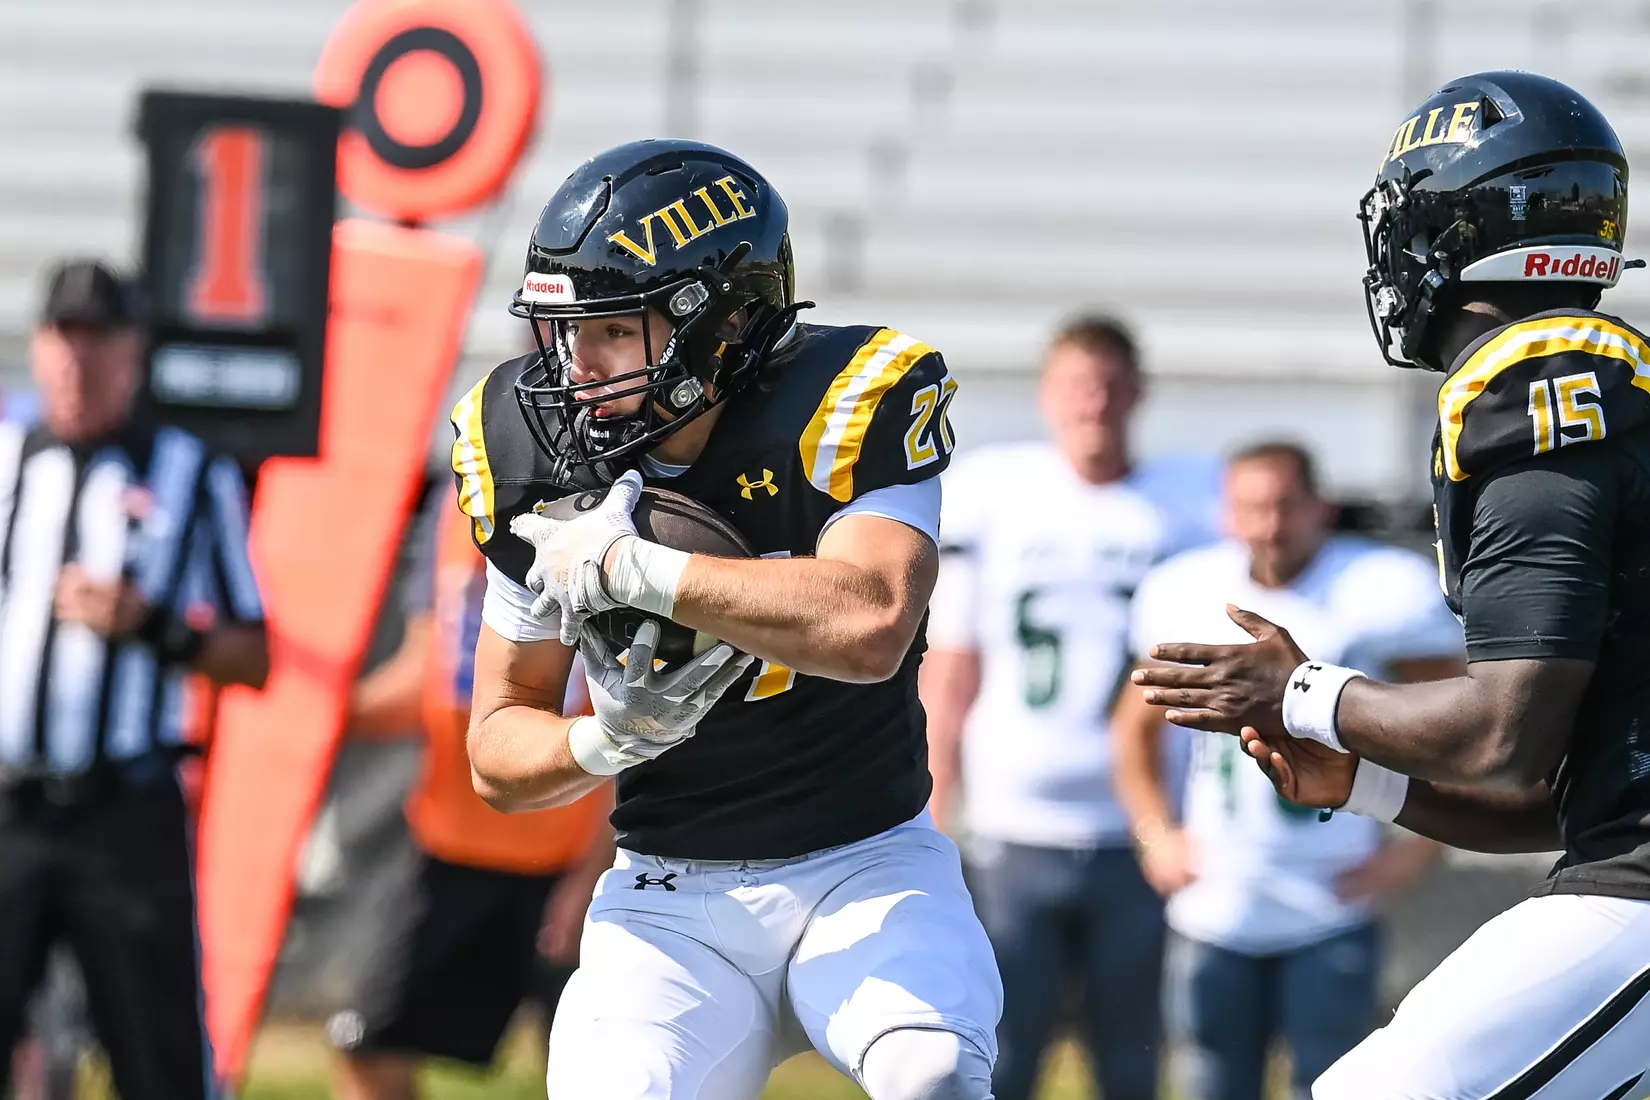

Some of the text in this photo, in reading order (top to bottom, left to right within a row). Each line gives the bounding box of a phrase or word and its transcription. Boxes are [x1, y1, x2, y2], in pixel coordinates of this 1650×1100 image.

[184, 124, 272, 320] 1
[606, 175, 757, 266] VILLE
[1600, 219, 1616, 240] 35
[526, 279, 564, 294] Riddell
[1524, 253, 1621, 281] Riddell
[903, 373, 959, 471] 27
[1527, 371, 1607, 456] 15
